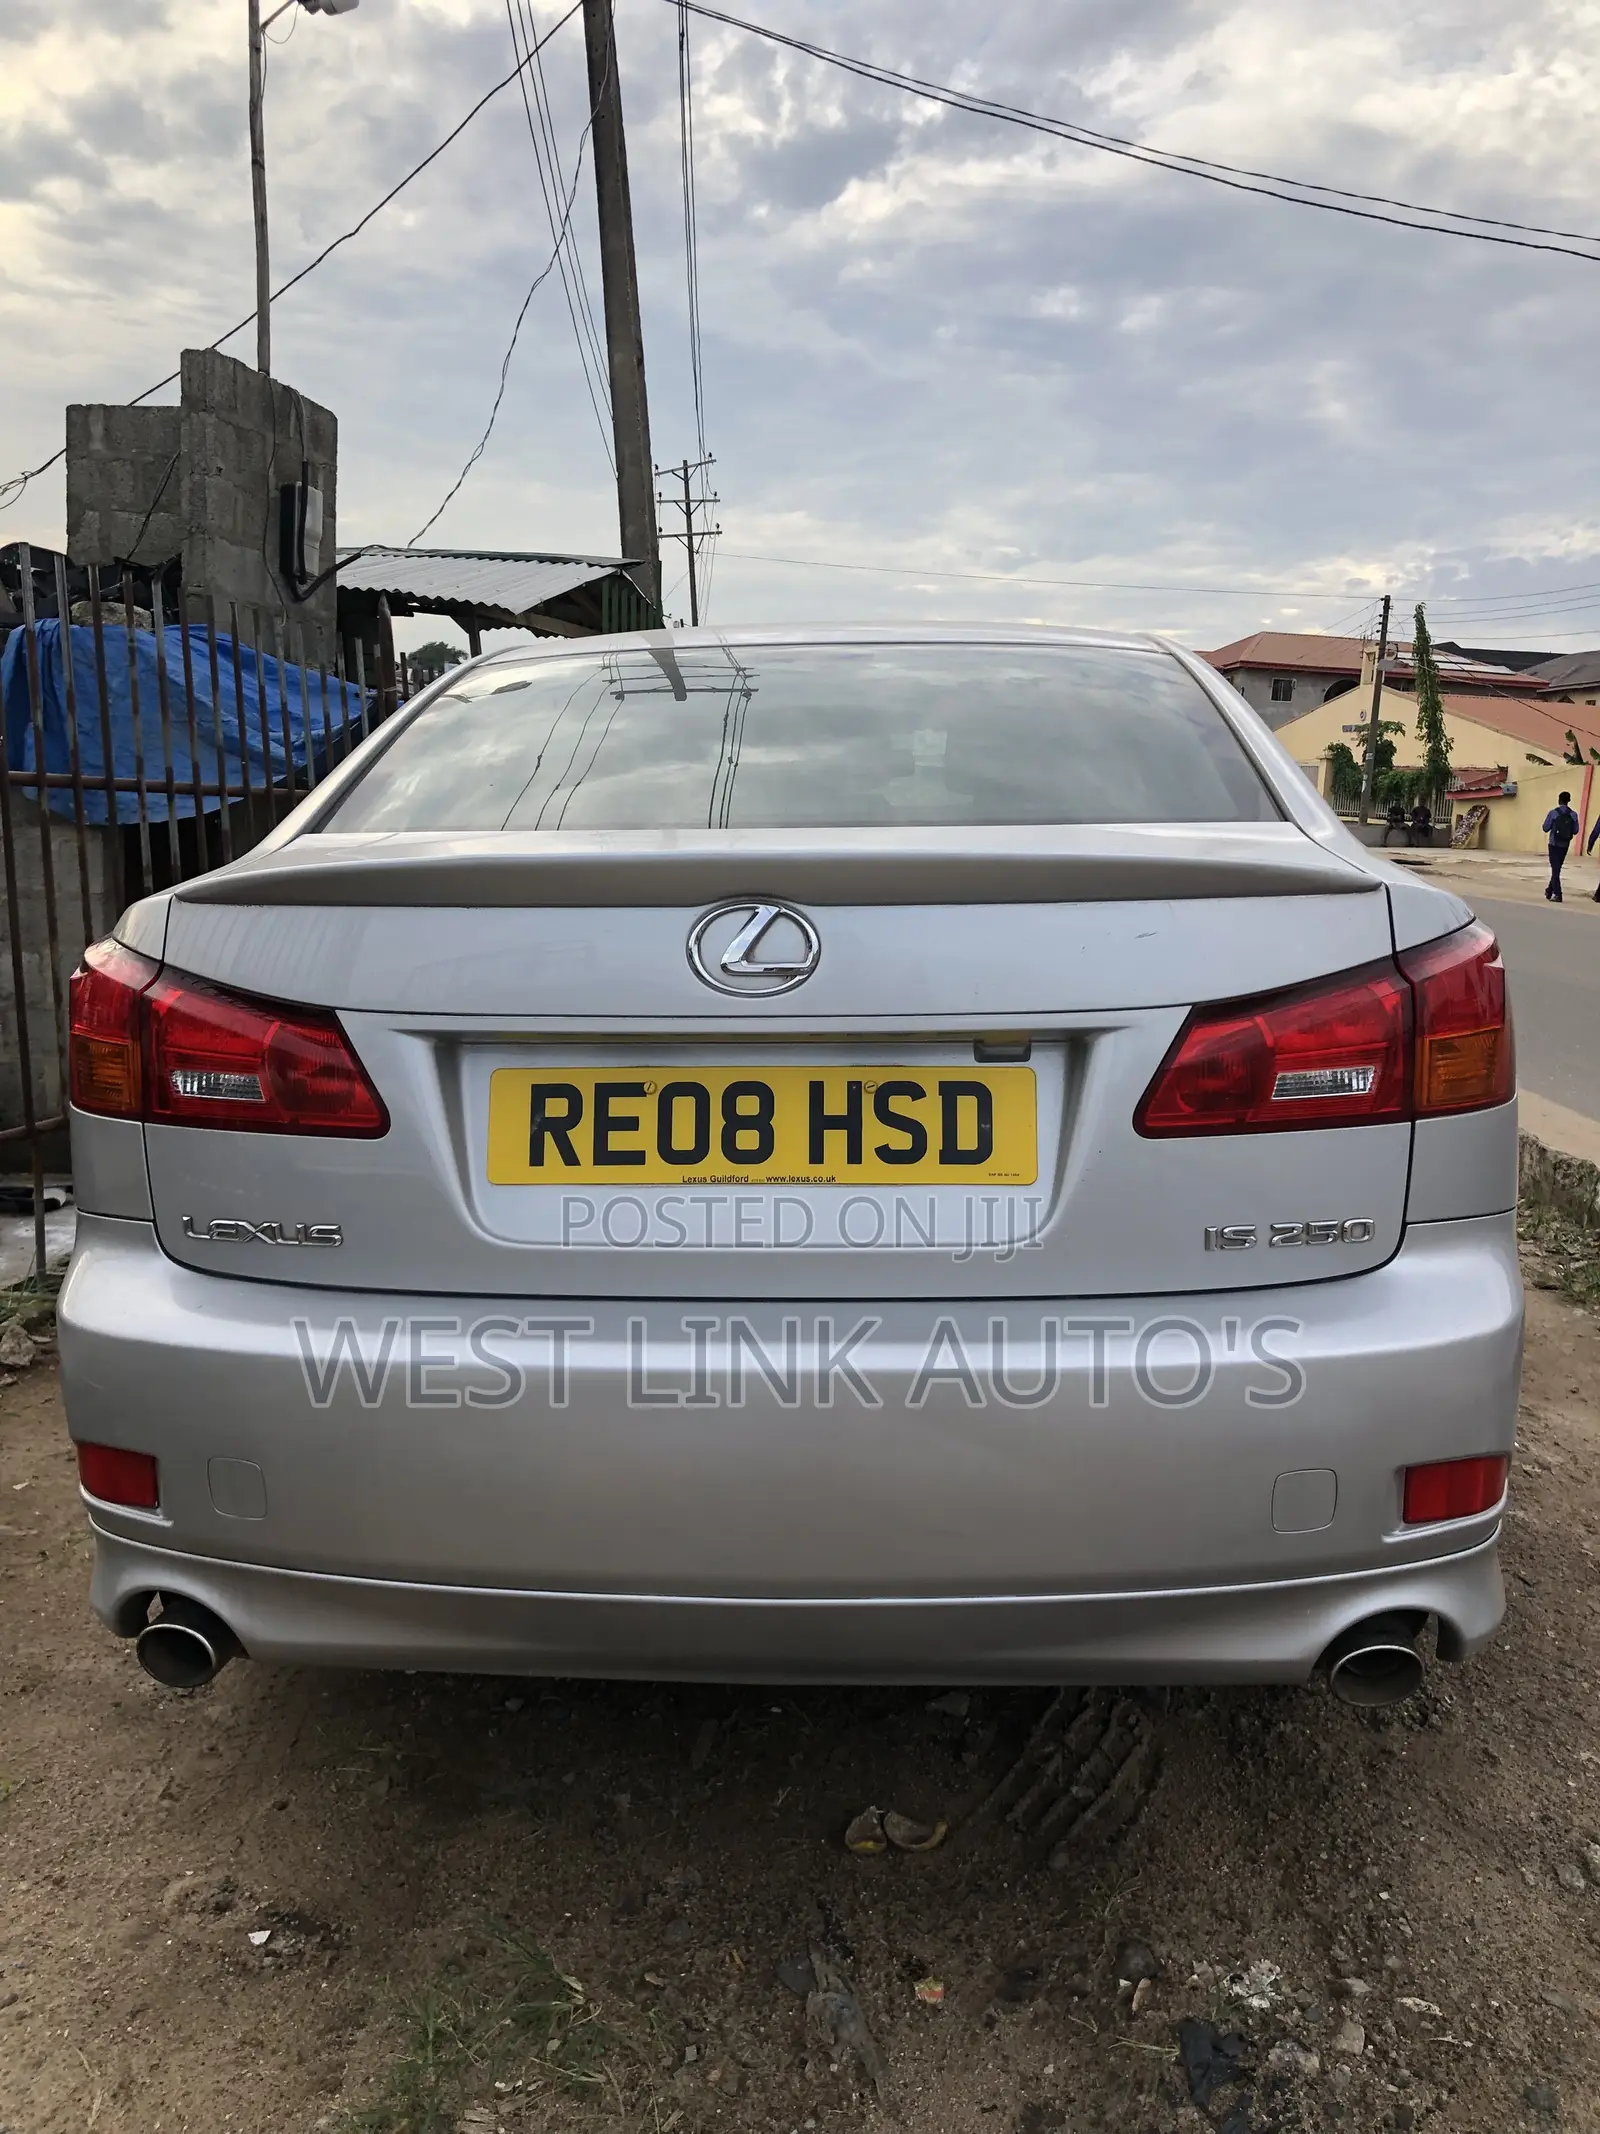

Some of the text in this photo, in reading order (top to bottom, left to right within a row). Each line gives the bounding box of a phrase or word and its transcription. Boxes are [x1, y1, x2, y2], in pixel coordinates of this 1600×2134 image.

[529, 1080, 994, 1167] RE08 HSD
[682, 1175, 707, 1183] Lexus
[710, 1175, 749, 1183] Guildford
[766, 1175, 836, 1183] www.lexus.co.uk
[182, 1215, 343, 1247] LEXUS
[1205, 1217, 1375, 1251] IS 250
